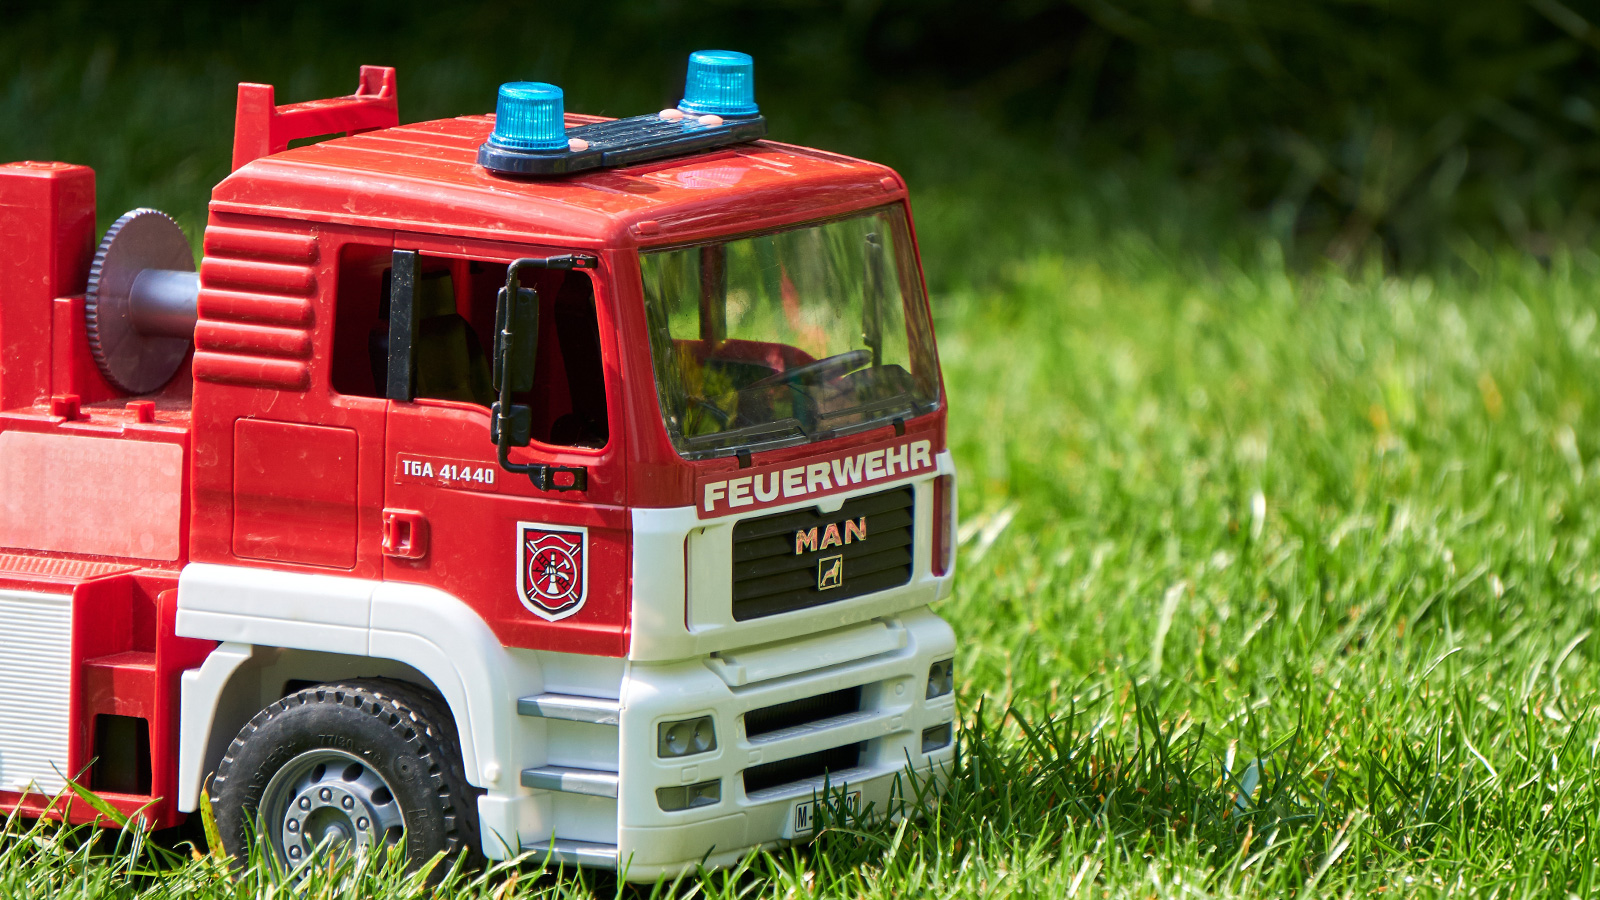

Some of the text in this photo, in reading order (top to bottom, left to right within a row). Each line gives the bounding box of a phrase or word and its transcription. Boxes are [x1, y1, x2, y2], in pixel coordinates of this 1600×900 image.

[402, 460, 495, 484] TGA 41.440
[704, 439, 932, 512] FEUERWEHR
[795, 516, 867, 555] MAN
